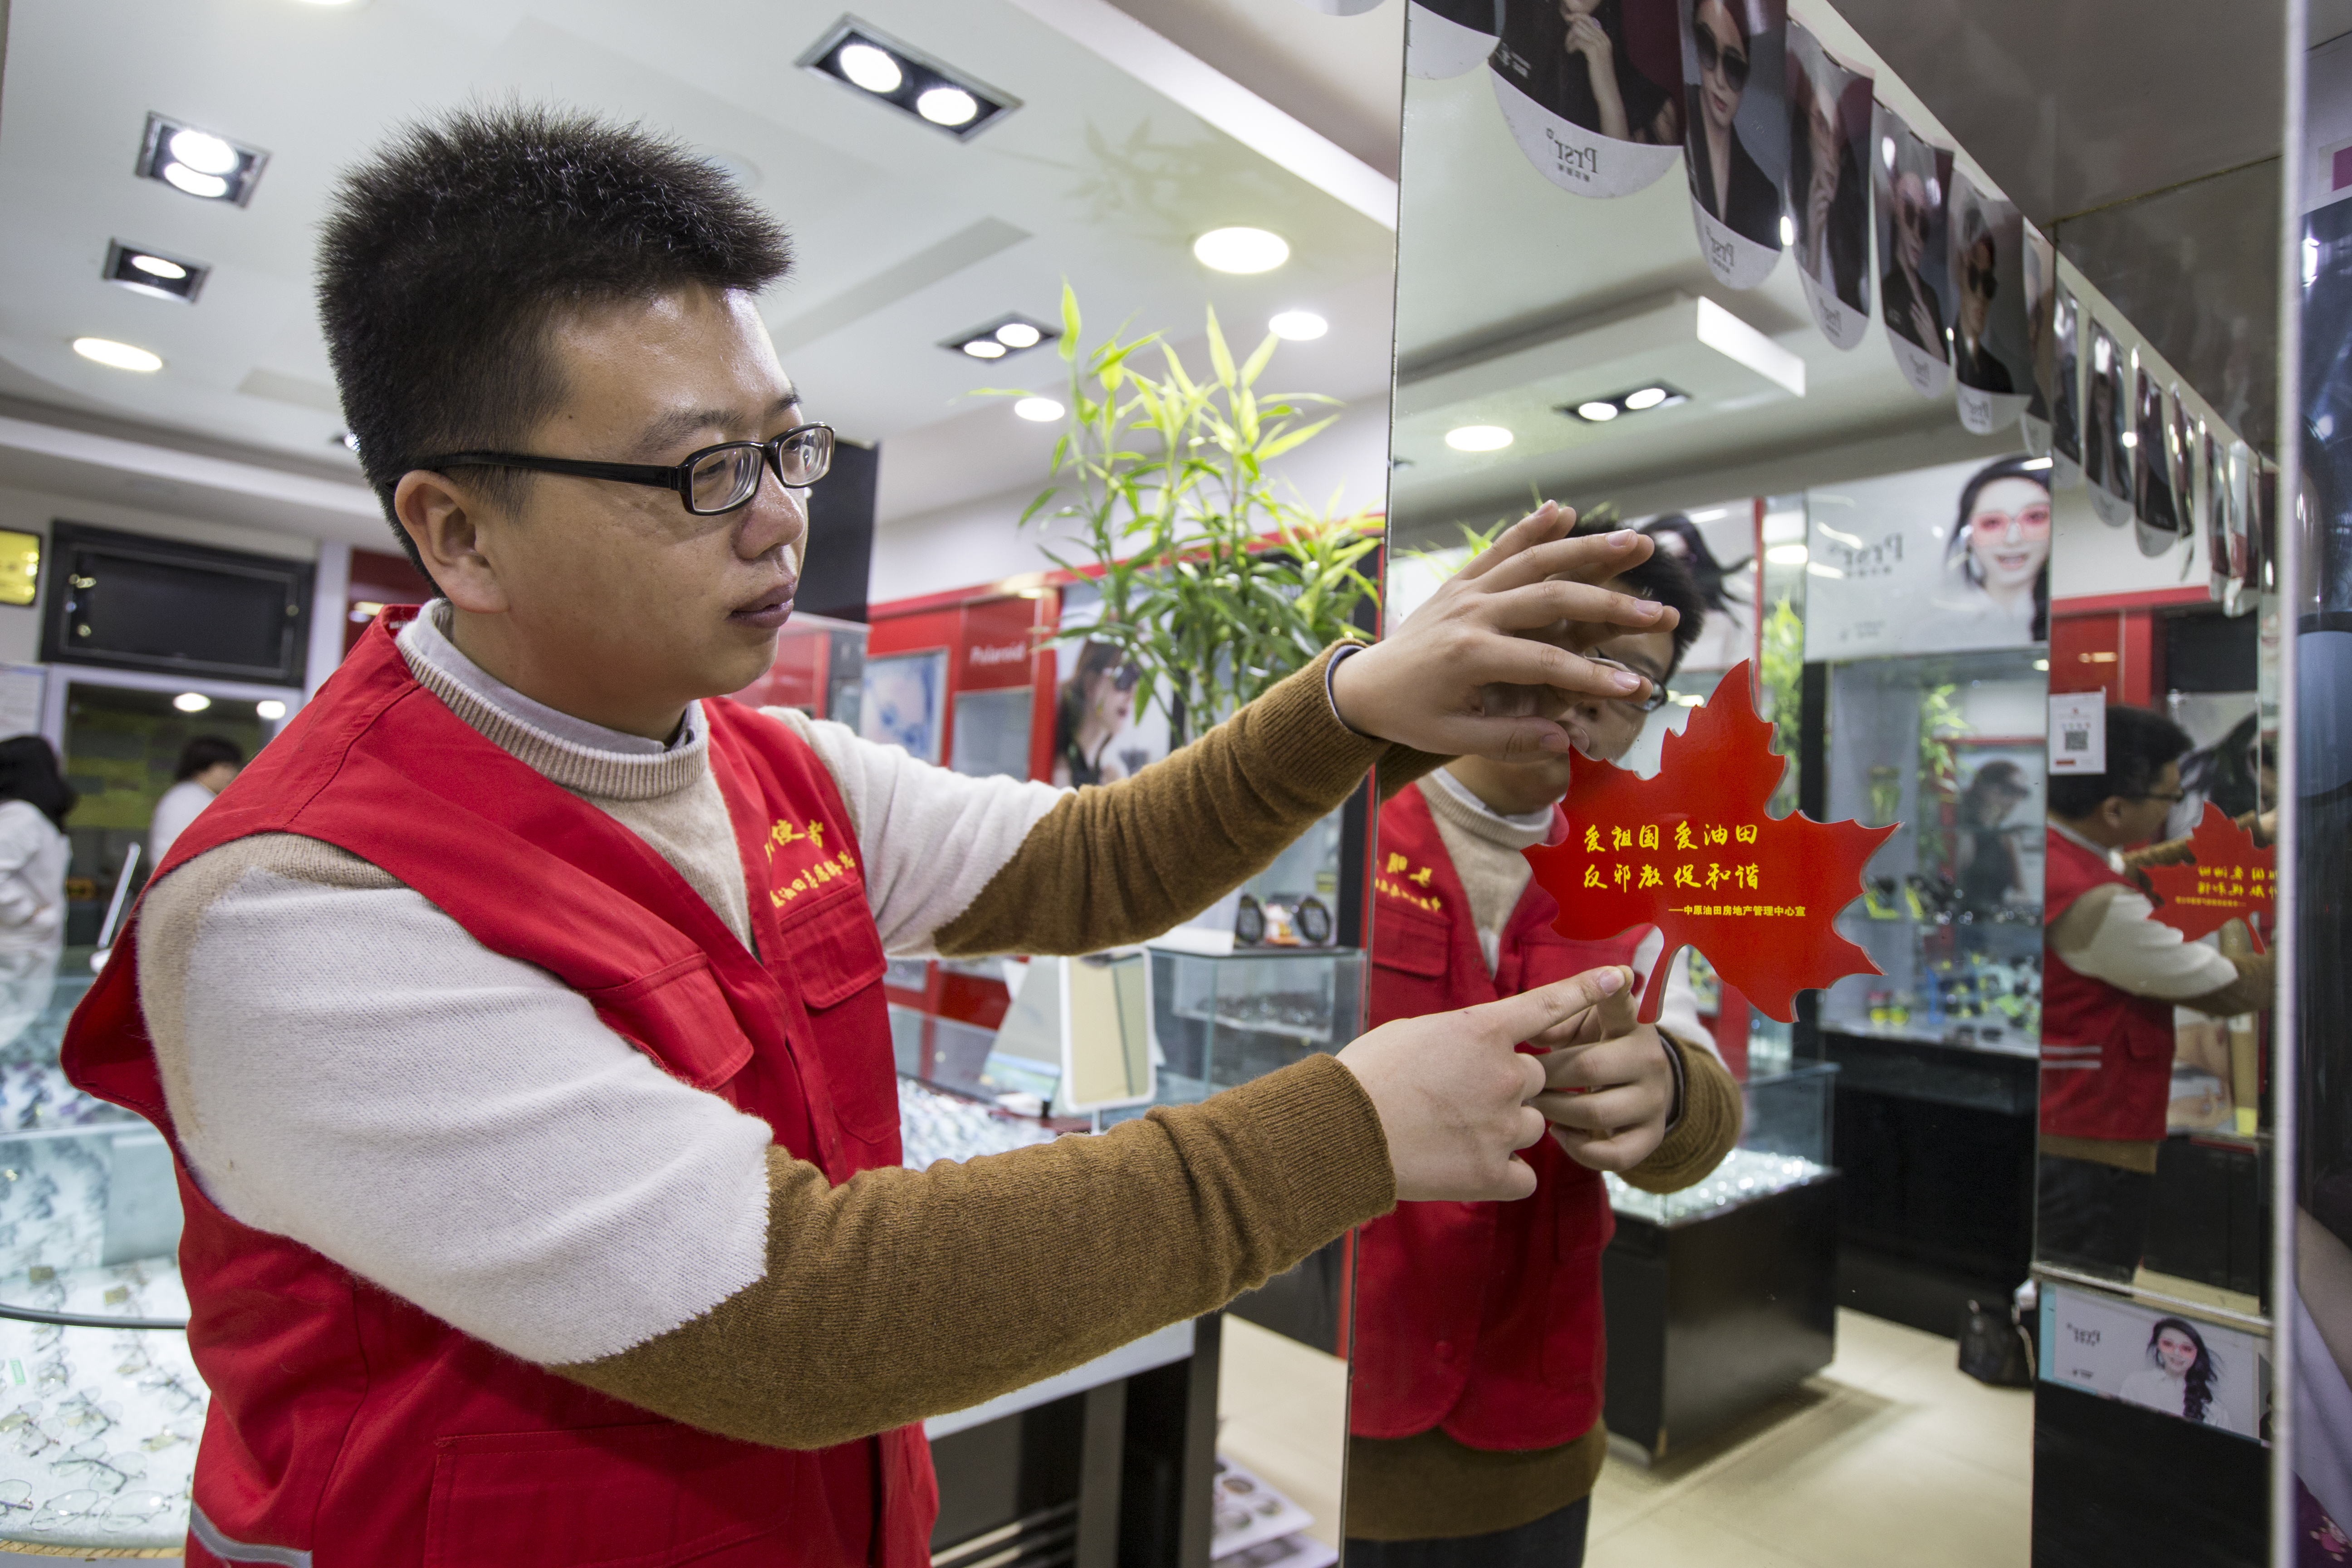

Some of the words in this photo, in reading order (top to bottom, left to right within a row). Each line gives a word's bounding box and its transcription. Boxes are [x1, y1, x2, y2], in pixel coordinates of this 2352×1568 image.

[1584, 824, 1659, 853] 爱祖国
[1674, 820, 1758, 850] 爱油田
[1583, 863, 1663, 893] 反邪教
[1673, 862, 1759, 891] 促和谐
